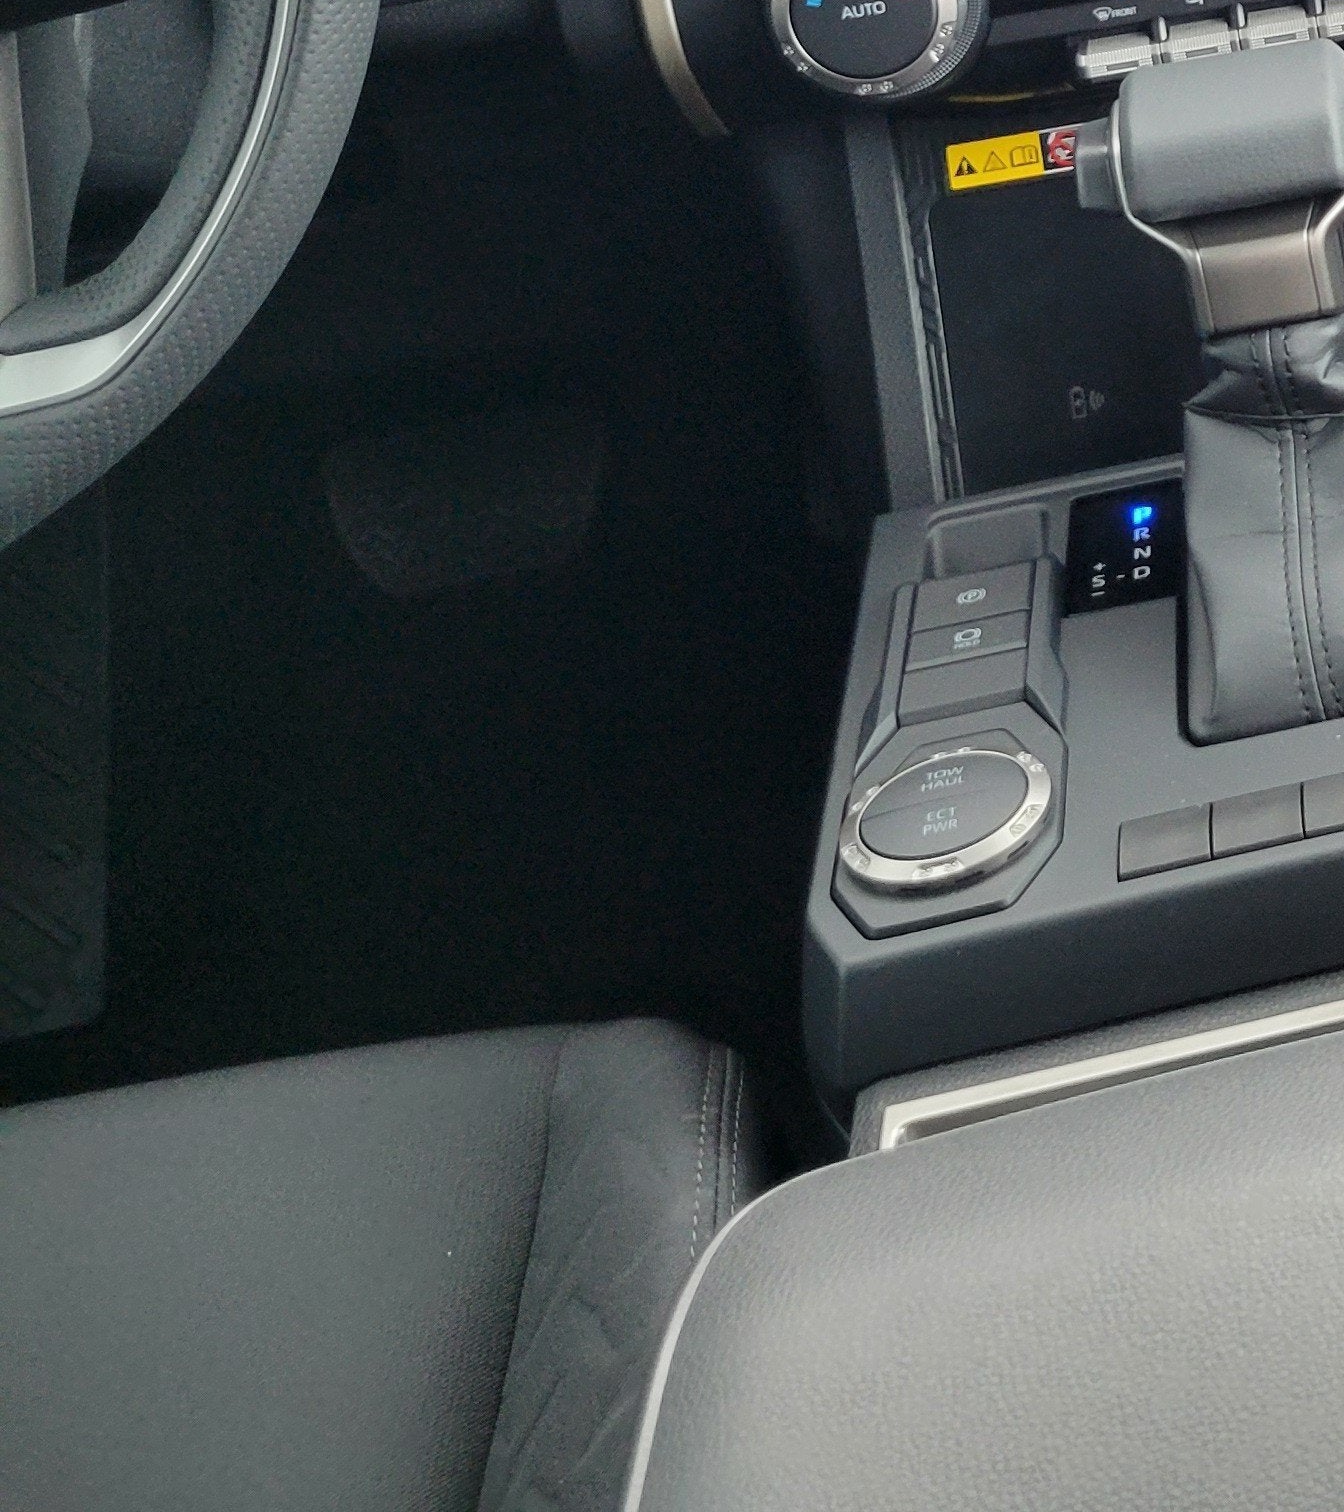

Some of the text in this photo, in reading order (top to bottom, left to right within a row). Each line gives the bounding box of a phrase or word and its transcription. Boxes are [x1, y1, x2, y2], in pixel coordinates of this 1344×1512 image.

[841, 0, 887, 21] AUTO
[1133, 506, 1152, 525] P
[1133, 527, 1151, 542] R
[1133, 545, 1152, 560] N
[1133, 565, 1151, 580] D
[1091, 574, 1106, 588] S
[927, 766, 964, 781] TOW
[921, 775, 964, 792] HAUL
[927, 806, 957, 822] ECT
[923, 818, 958, 836] PWR
